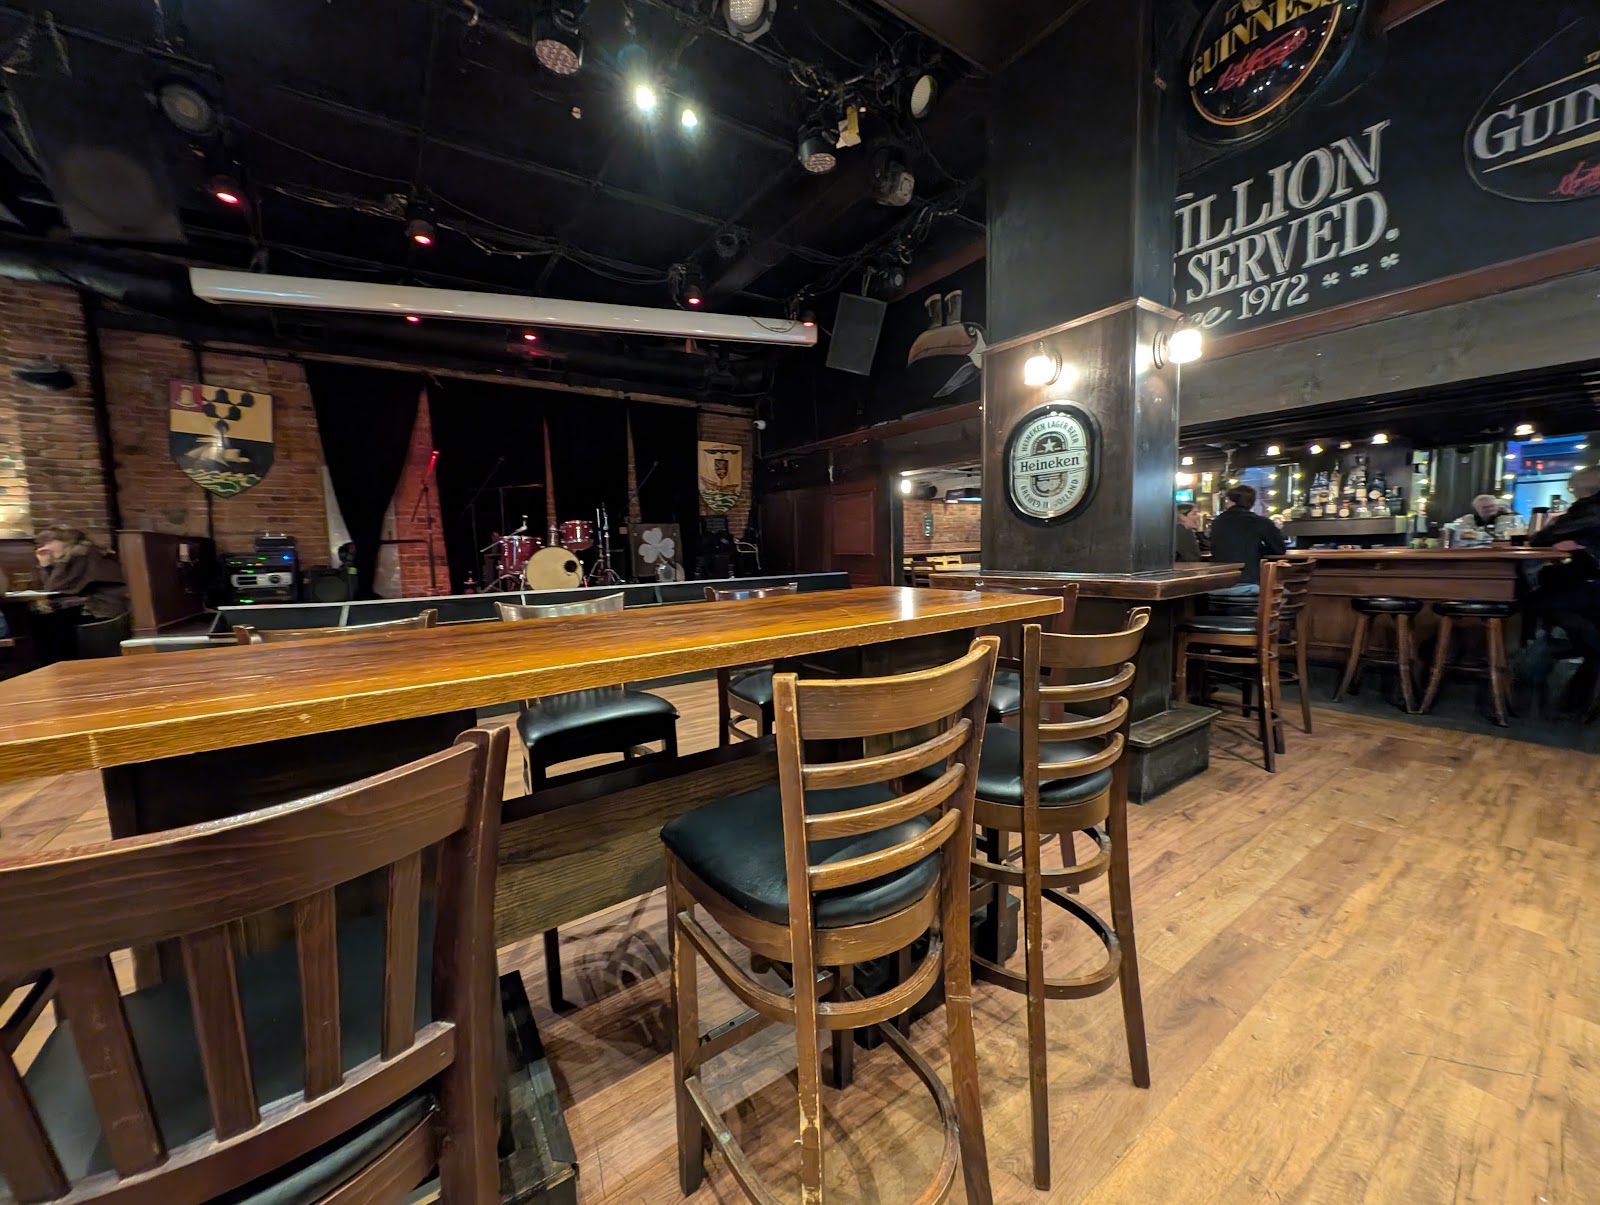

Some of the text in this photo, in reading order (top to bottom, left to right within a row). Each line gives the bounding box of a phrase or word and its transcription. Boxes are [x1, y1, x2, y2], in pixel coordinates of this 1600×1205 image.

[1188, 0, 1337, 86] GUINNE
[1174, 119, 1391, 258] ILLION
[1186, 190, 1400, 304] SERVED.
[1237, 273, 1309, 320] 1972
[1020, 456, 1080, 473] Heineken
[1021, 420, 1080, 452] HEINEKEN LAGER BEER
